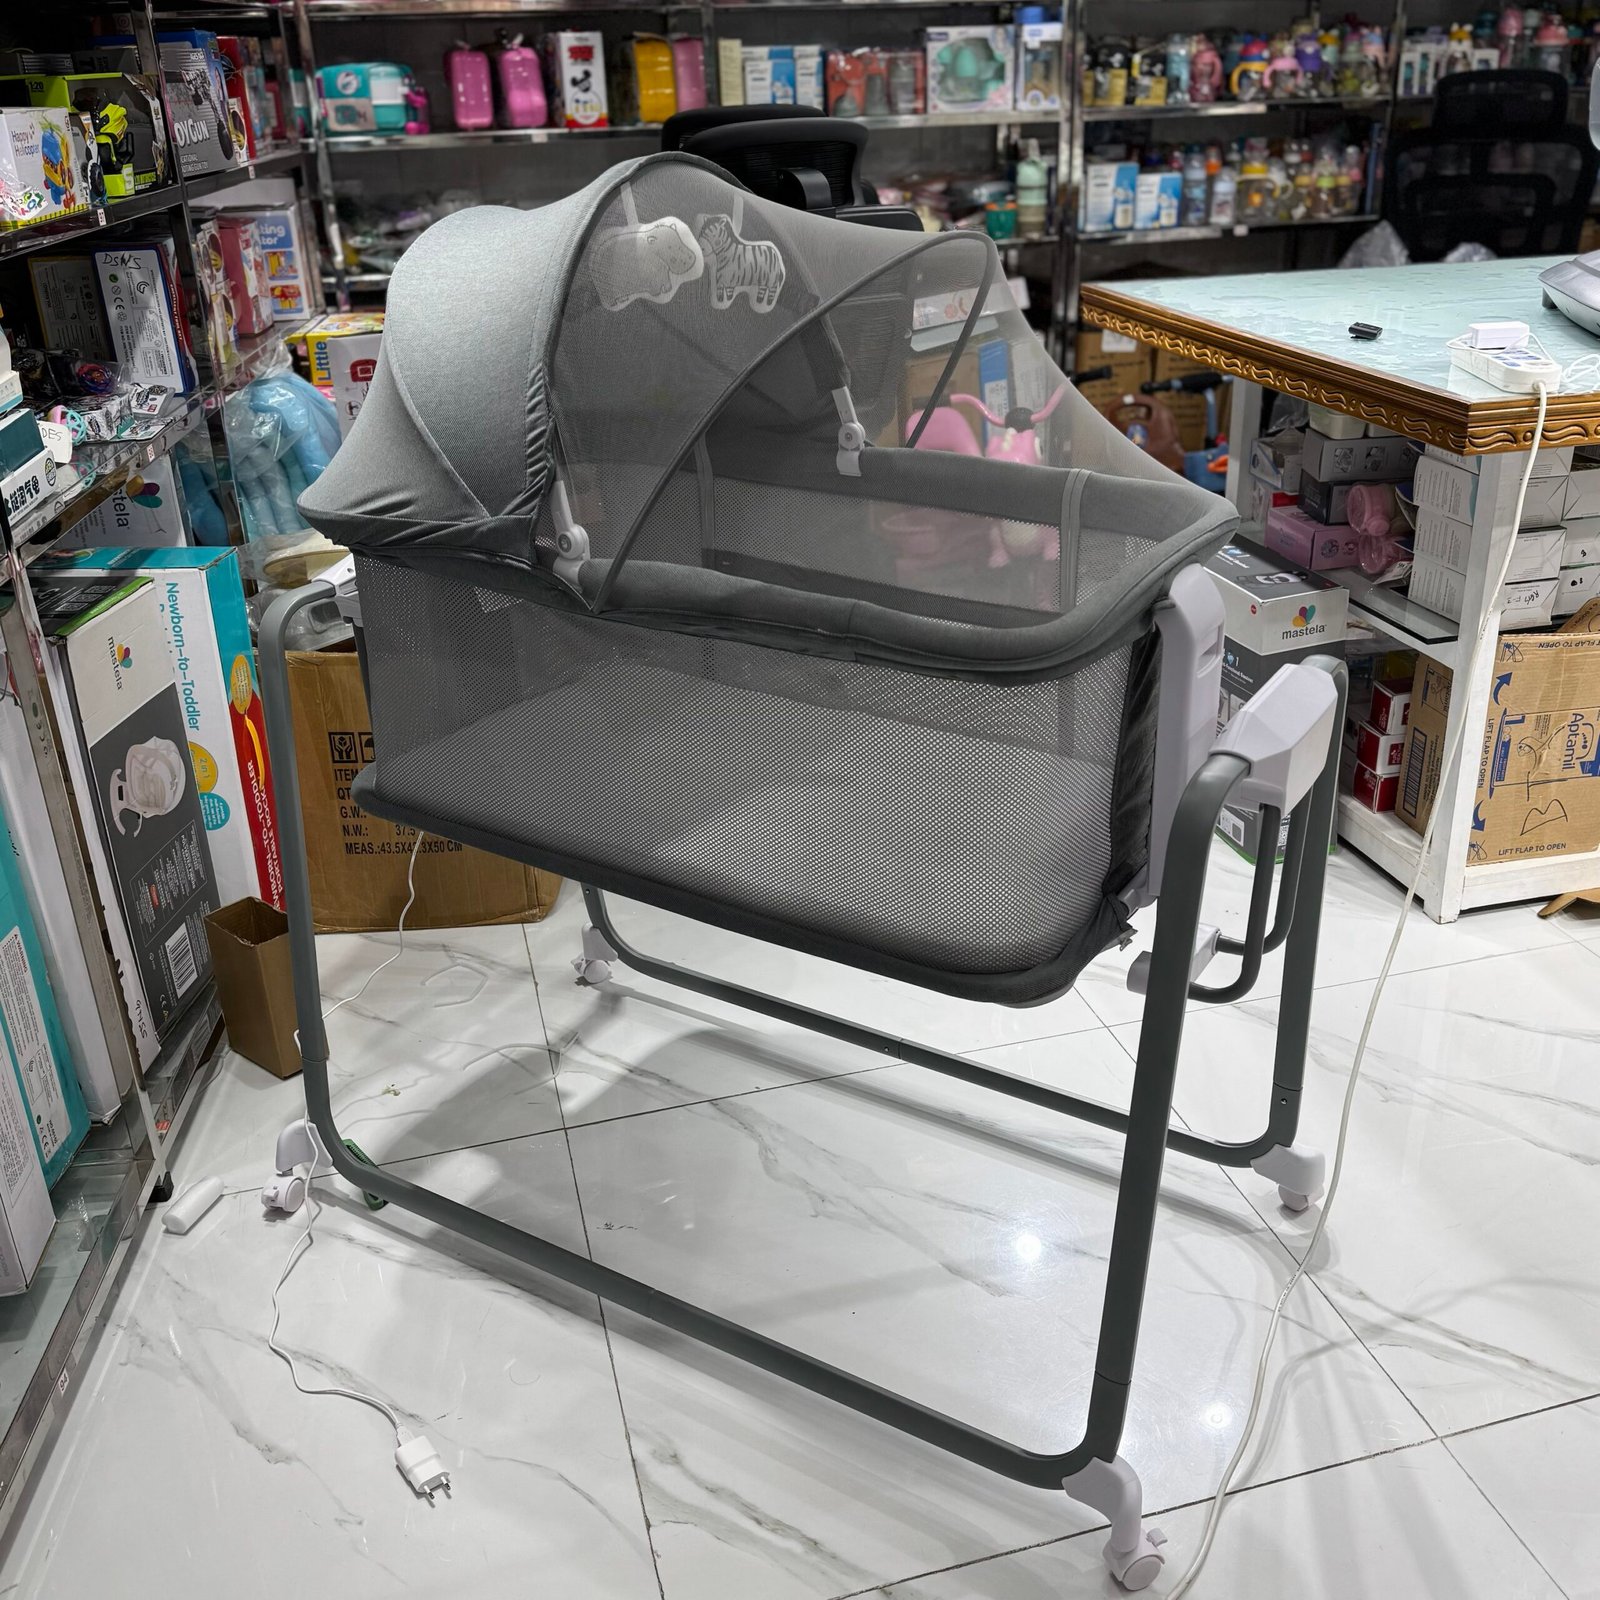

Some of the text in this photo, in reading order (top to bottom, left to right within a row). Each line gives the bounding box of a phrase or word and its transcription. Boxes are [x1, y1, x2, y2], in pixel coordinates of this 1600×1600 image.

[173, 118, 211, 148] OYGUN
[259, 224, 286, 238] ting
[259, 237, 278, 246] tor
[314, 340, 331, 381] Little
[41, 427, 63, 441] DES
[1282, 624, 1326, 640] mastela
[1574, 640, 1594, 648] FLAP
[106, 636, 123, 691] mastela
[1484, 733, 1492, 754] FLAP
[1562, 712, 1584, 772] Aptamil
[1482, 756, 1488, 767] TO
[1478, 768, 1487, 789] OPEN
[337, 787, 351, 801] QT
[247, 759, 281, 911] EWBORN-TO-TODDLER
[342, 824, 369, 837] N.W.:
[1498, 848, 1513, 856] LIFT
[1515, 846, 1534, 854] FLAP
[1546, 843, 1566, 851] OPEN
[269, 827, 283, 894] PORTABLE
